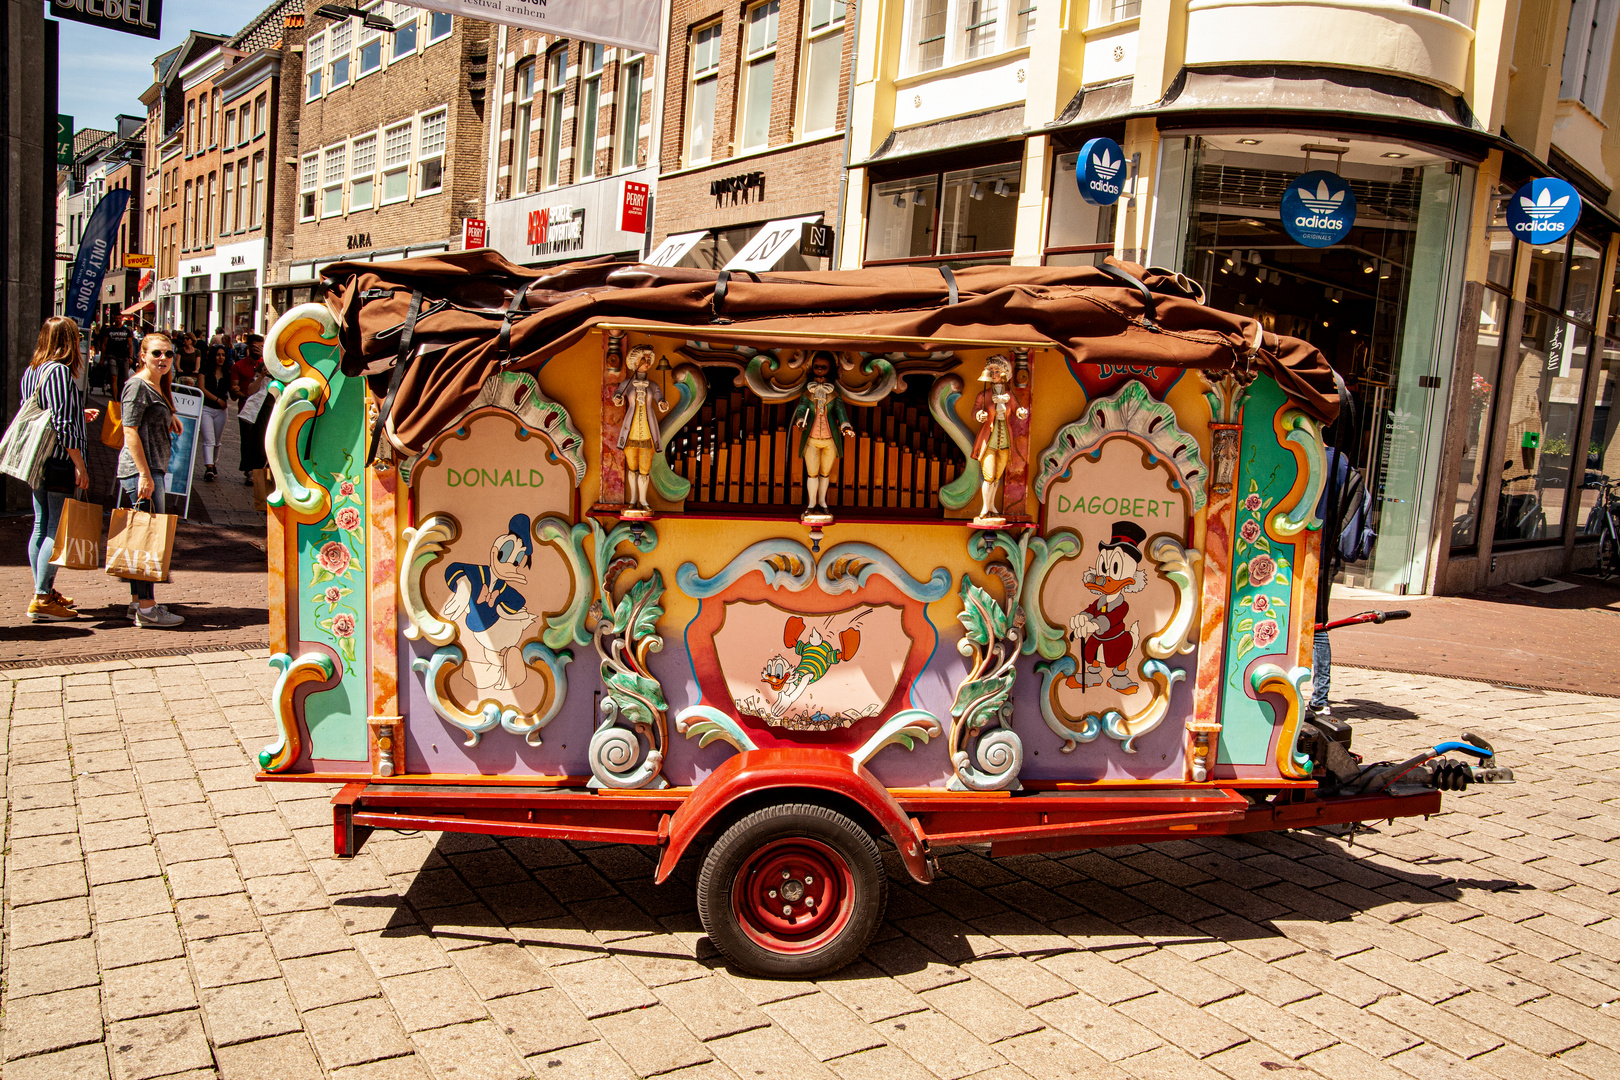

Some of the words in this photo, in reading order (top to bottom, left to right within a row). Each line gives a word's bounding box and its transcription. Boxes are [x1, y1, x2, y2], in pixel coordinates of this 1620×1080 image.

[56, 0, 156, 29] EBEL
[505, 5, 546, 19] arnhem
[1089, 180, 1119, 195] adidas
[626, 192, 645, 207] PERRY
[527, 207, 549, 246] PERRY
[1295, 214, 1343, 230] adidas
[1515, 219, 1565, 232] adidas
[468, 227, 483, 238] PERRY
[1303, 233, 1332, 241] ORIGINALS
[346, 232, 372, 249] ZARA
[89, 238, 107, 270] ONLY
[804, 246, 829, 256] NIKKIE
[230, 255, 245, 266] ZARA
[85, 269, 97, 278] &
[76, 279, 96, 312] SONS
[447, 467, 544, 488] DONALD
[1057, 494, 1176, 518] DAGOBERT
[106, 546, 162, 578] ZARA
